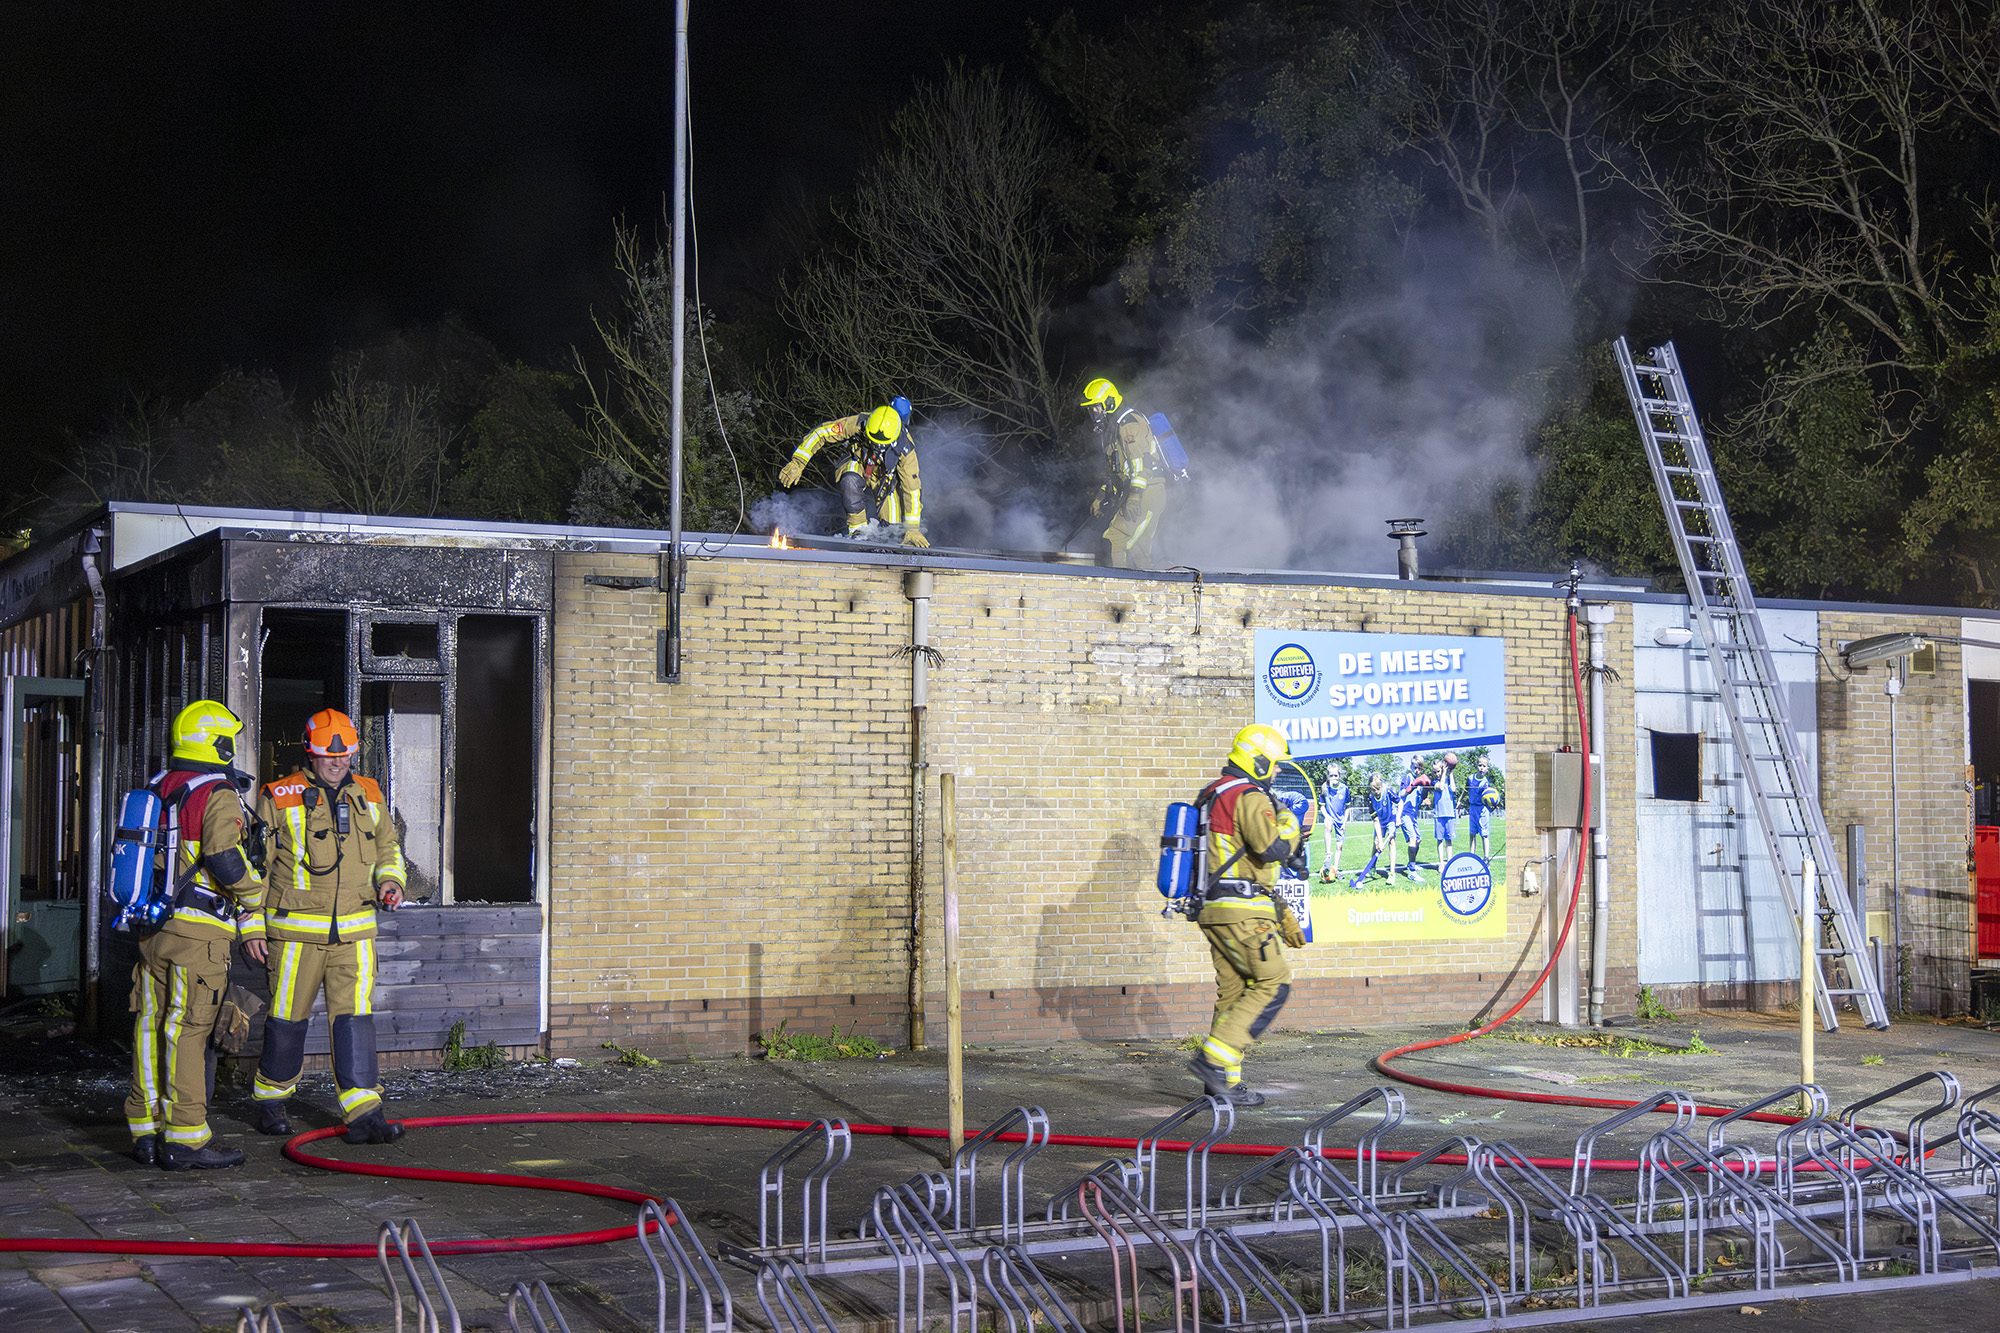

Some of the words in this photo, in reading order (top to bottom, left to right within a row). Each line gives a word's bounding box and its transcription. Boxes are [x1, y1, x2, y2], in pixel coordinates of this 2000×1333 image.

[1270, 664, 1314, 678] SPORTFEVER
[1339, 652, 1373, 675] DE
[1380, 648, 1464, 673] MEEST
[1329, 679, 1469, 707] SPORTIEVE
[1272, 708, 1485, 741] KINDEROPVANG!
[274, 784, 306, 797] OVD
[1442, 875, 1490, 892] SPORTFEVER
[1347, 906, 1423, 927] Sportfever.nl
